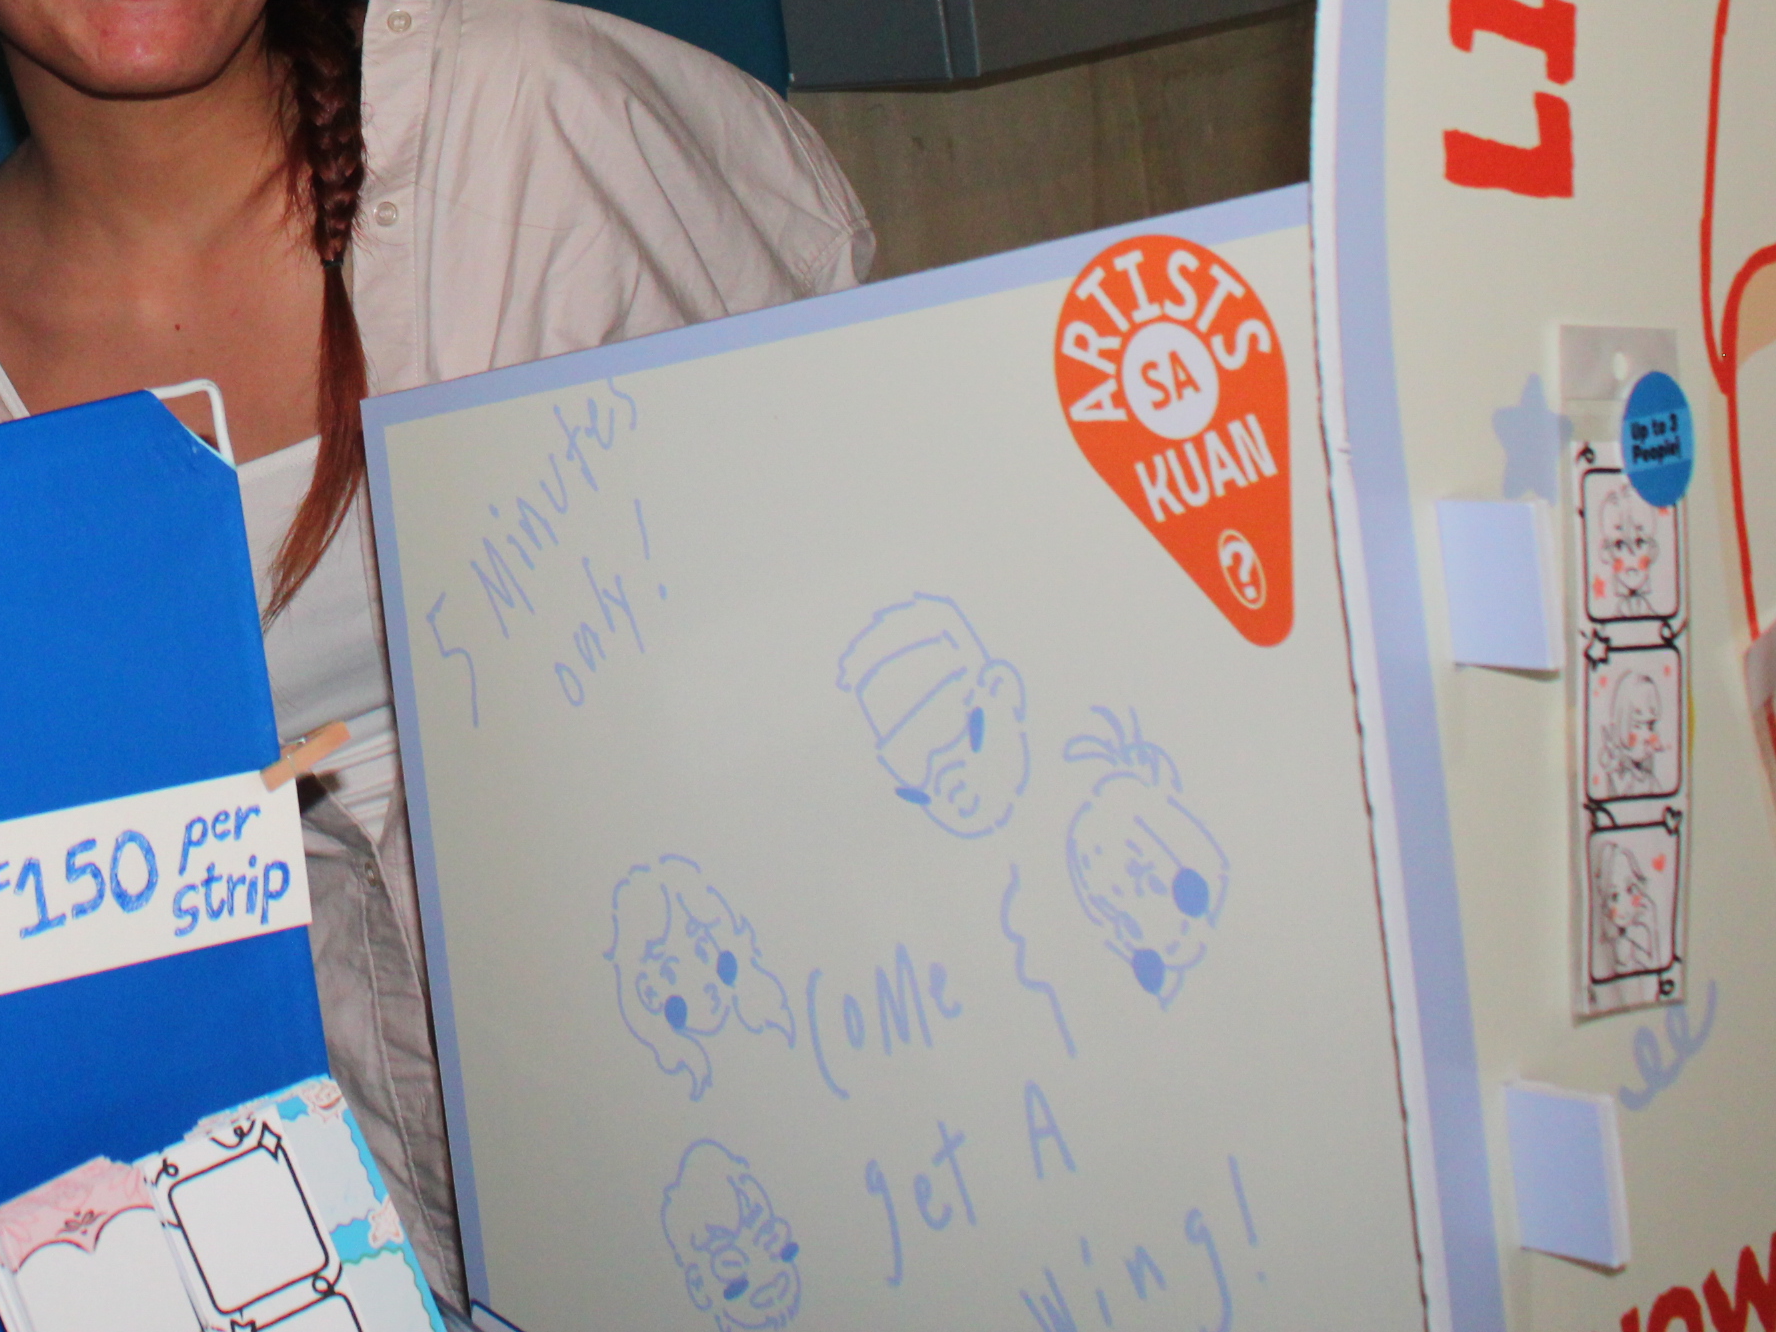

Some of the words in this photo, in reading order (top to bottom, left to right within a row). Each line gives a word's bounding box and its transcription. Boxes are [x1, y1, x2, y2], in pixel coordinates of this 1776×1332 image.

[1061, 249, 1272, 423] ARTISTS
[1140, 349, 1202, 411] SA
[1134, 413, 1279, 524] KUAN
[1630, 421, 1648, 445] Up
[1651, 417, 1666, 436] to
[1669, 412, 1678, 432] 3
[426, 590, 479, 728] 5
[178, 804, 261, 876] per
[172, 854, 291, 937] strip
[865, 1120, 976, 1288] get
